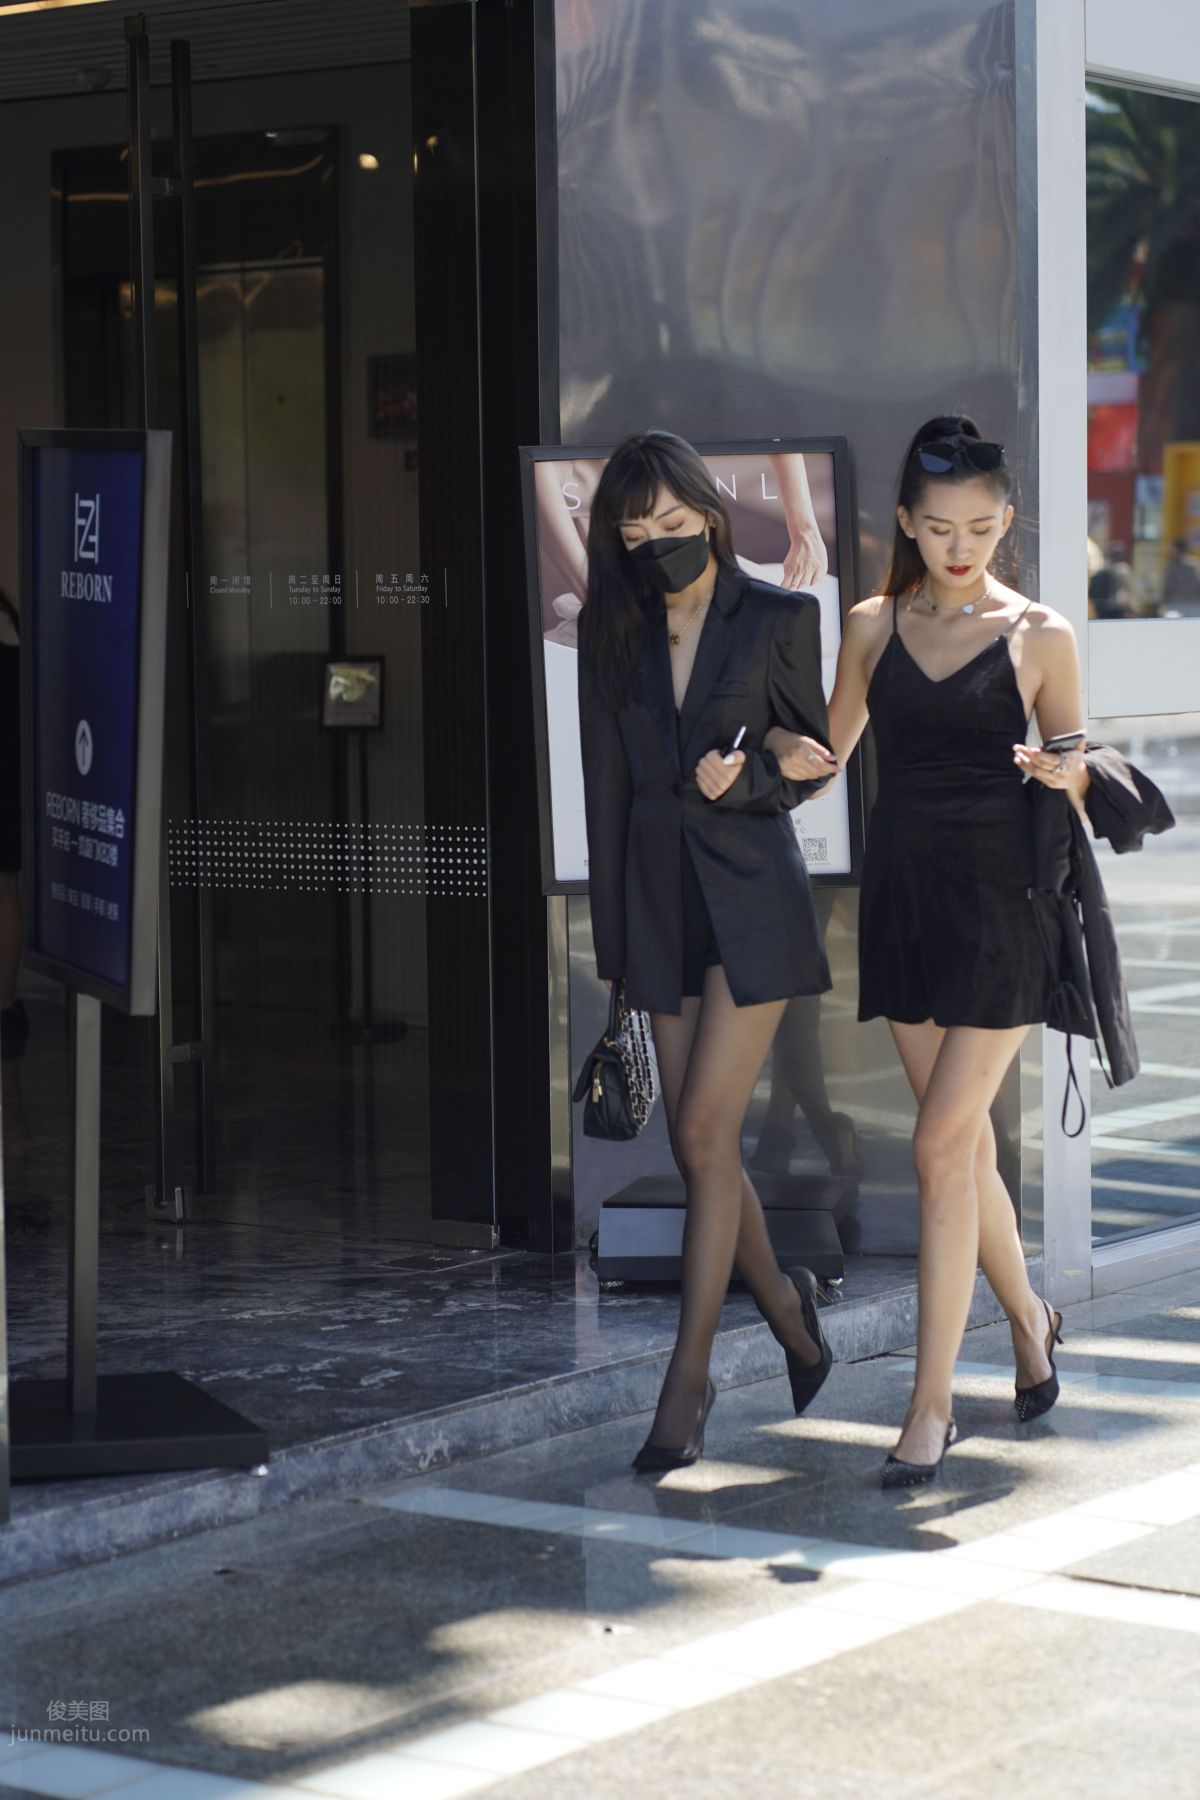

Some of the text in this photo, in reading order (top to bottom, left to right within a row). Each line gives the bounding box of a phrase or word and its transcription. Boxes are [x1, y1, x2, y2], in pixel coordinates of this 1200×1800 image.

[288, 574, 341, 585] 周二至周日
[375, 573, 429, 584] 周五周六
[61, 571, 113, 603] REBORN
[289, 586, 311, 595] Tuesday
[320, 586, 341, 595] Sunday
[376, 585, 393, 593] Friday
[403, 584, 428, 593] Saturday
